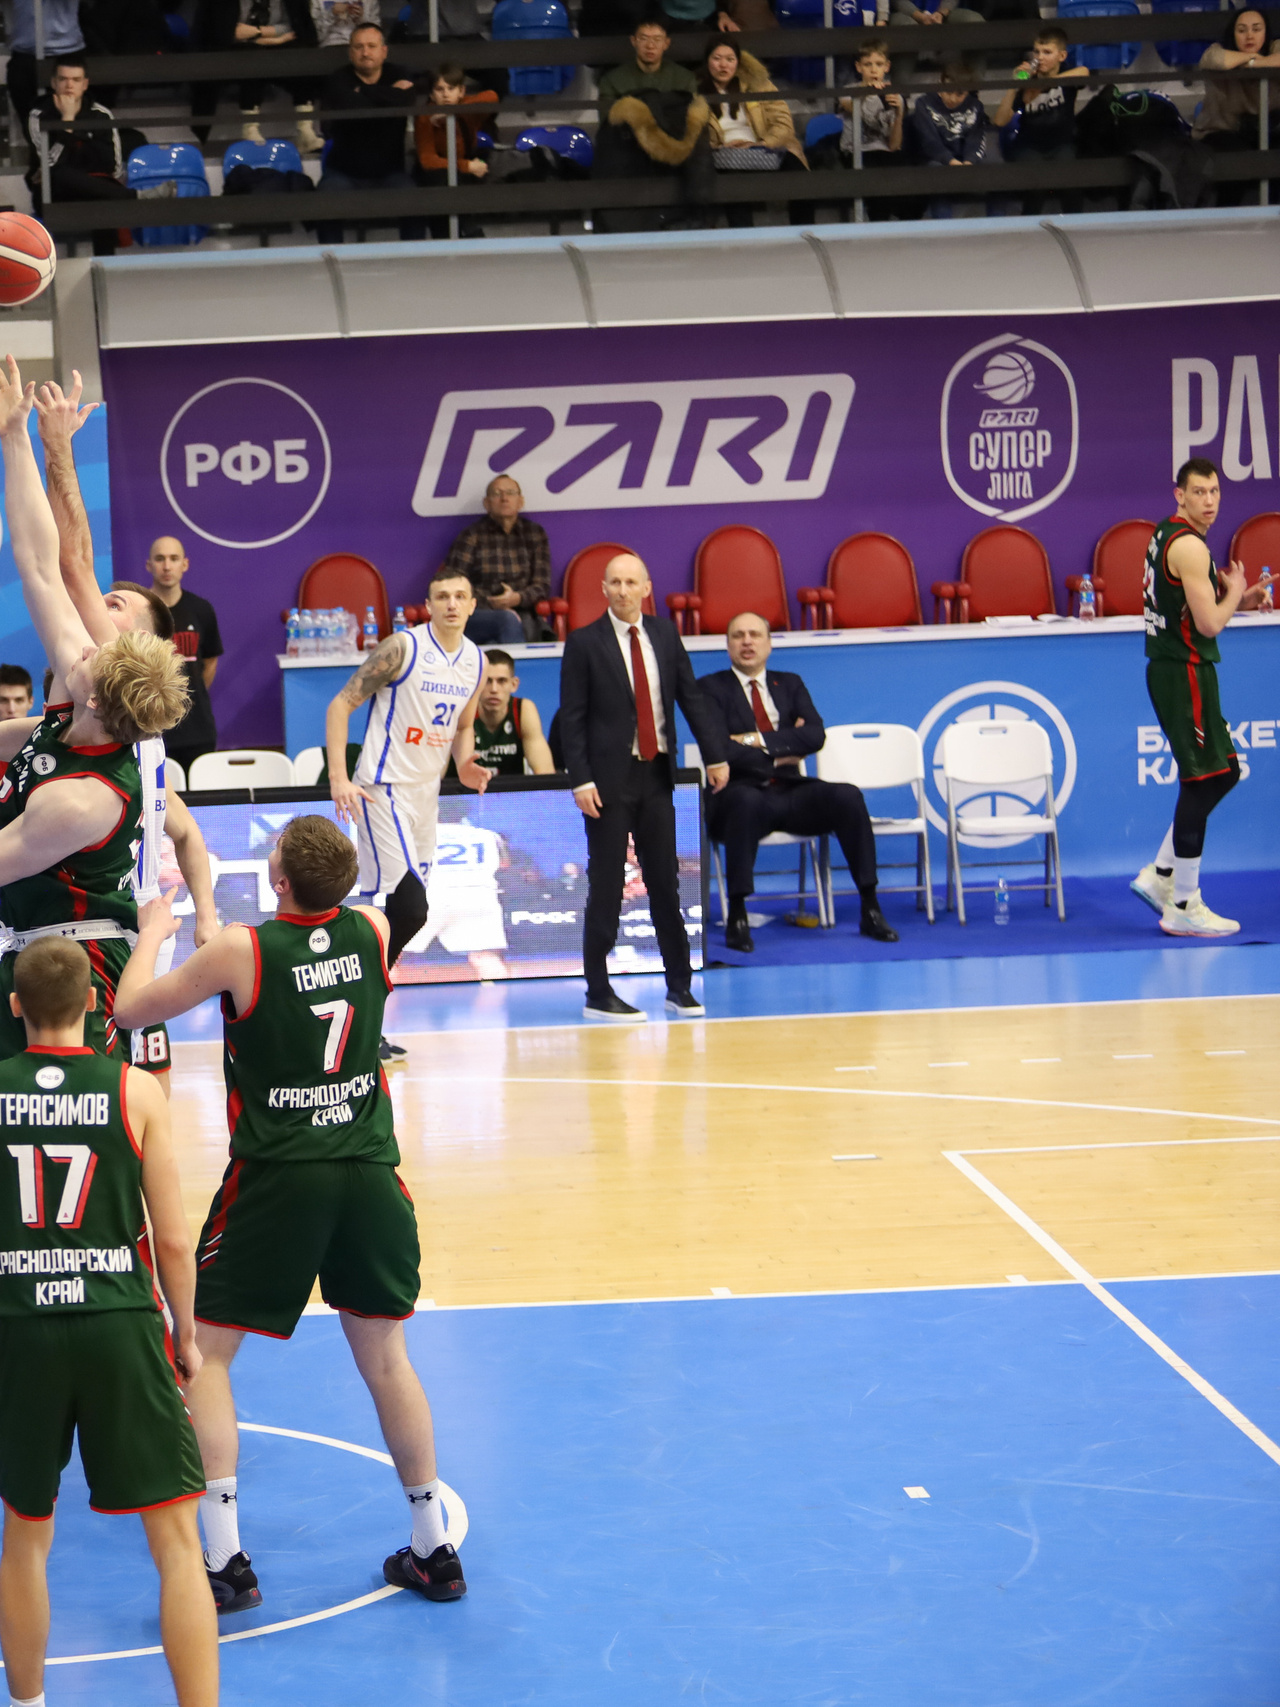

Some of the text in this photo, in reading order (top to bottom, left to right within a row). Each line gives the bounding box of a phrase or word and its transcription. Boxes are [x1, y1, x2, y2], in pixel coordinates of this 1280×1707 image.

[980, 407, 1039, 428] PARI
[433, 390, 832, 498] PARI
[969, 429, 1052, 471] СУПЕР
[185, 438, 310, 487] РФБ
[987, 471, 1033, 500] ЛИГА
[420, 680, 469, 698] ДИНАМО
[432, 703, 456, 726] 21
[437, 842, 485, 866] 21
[312, 936, 326, 944] РФБ
[291, 953, 363, 993] ТЕМИРОВ
[309, 999, 355, 1074] 7
[41, 1073, 60, 1081] РФБ
[311, 1102, 353, 1127] КРАЙ
[6, 1144, 99, 1229] 17
[35, 1276, 85, 1306] КРАЙ
